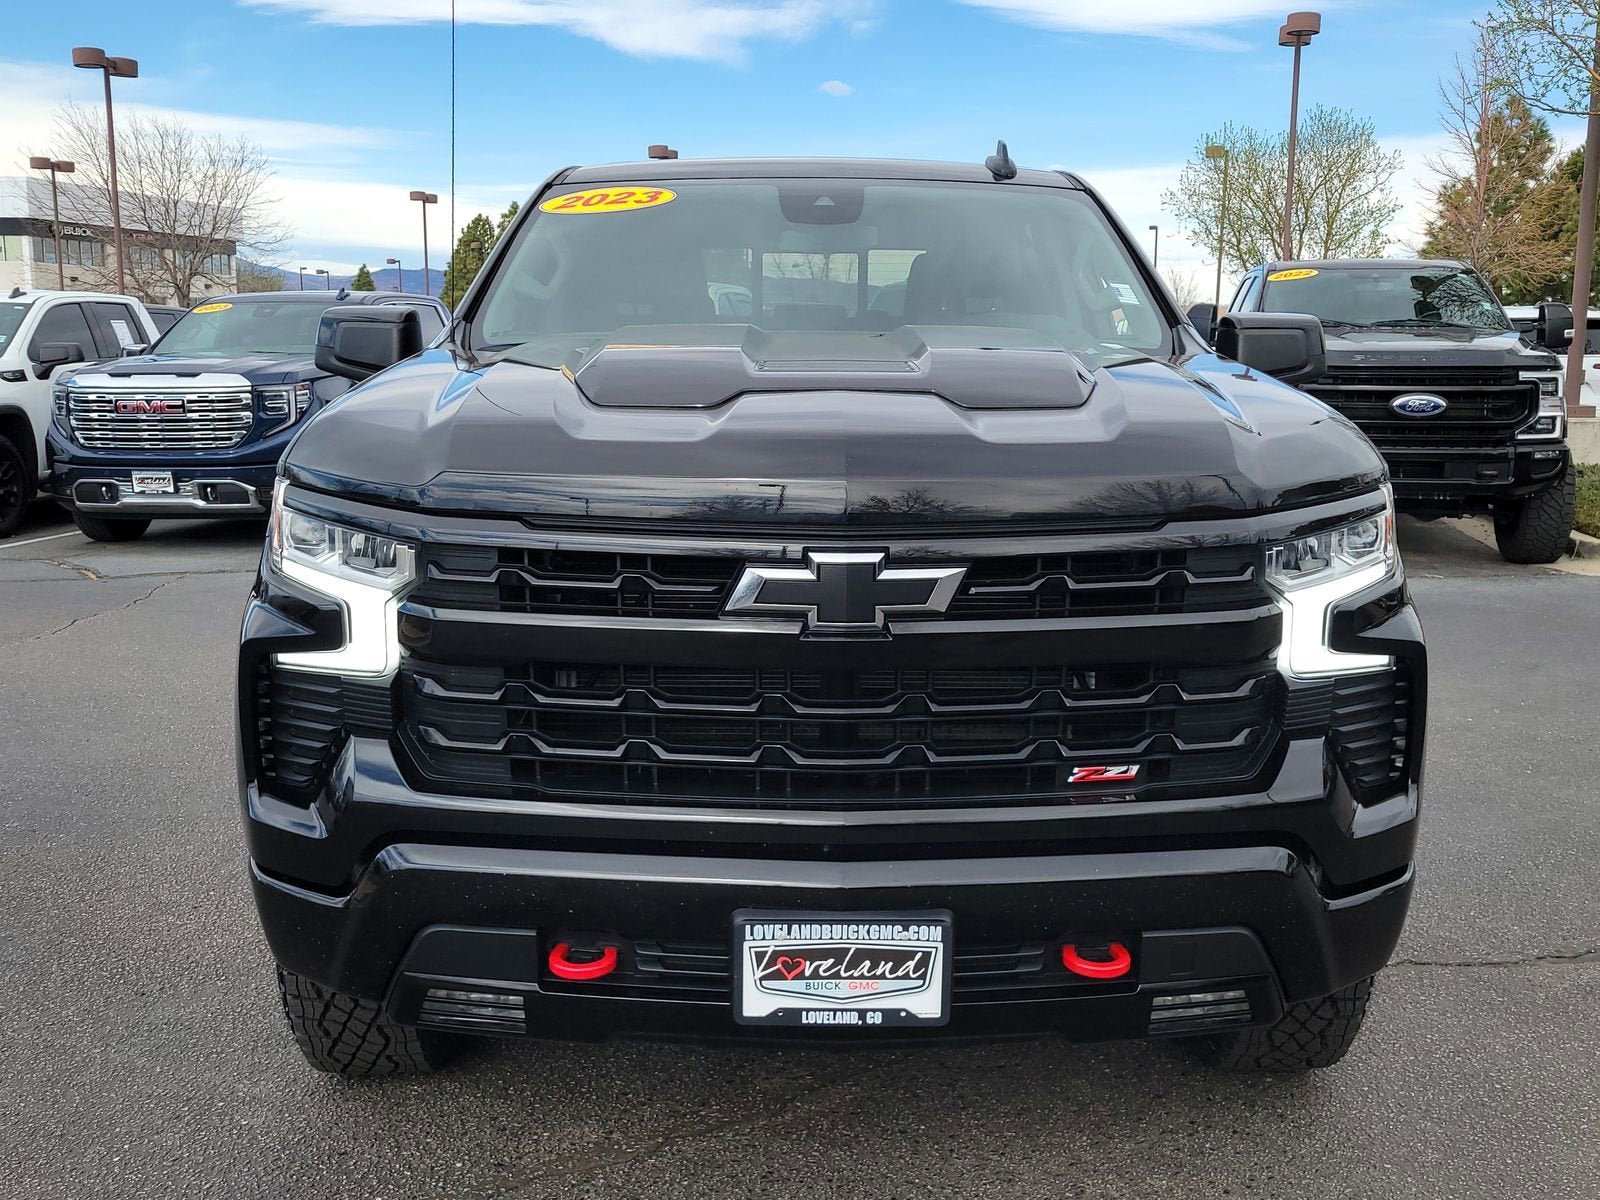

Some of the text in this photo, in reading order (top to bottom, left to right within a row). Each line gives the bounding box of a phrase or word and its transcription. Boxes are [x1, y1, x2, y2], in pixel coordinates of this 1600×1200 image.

[552, 190, 664, 210] 2023
[64, 226, 97, 236] BUICK
[1272, 270, 1313, 280] 2022
[117, 400, 183, 414] GMC
[1405, 399, 1434, 412] Ford
[744, 924, 942, 941] LOVELANDBUICKGMC.COM
[753, 945, 925, 981] Loveland
[805, 981, 880, 991] BUICK GMC
[801, 1011, 882, 1025] LOVELAND, CO
